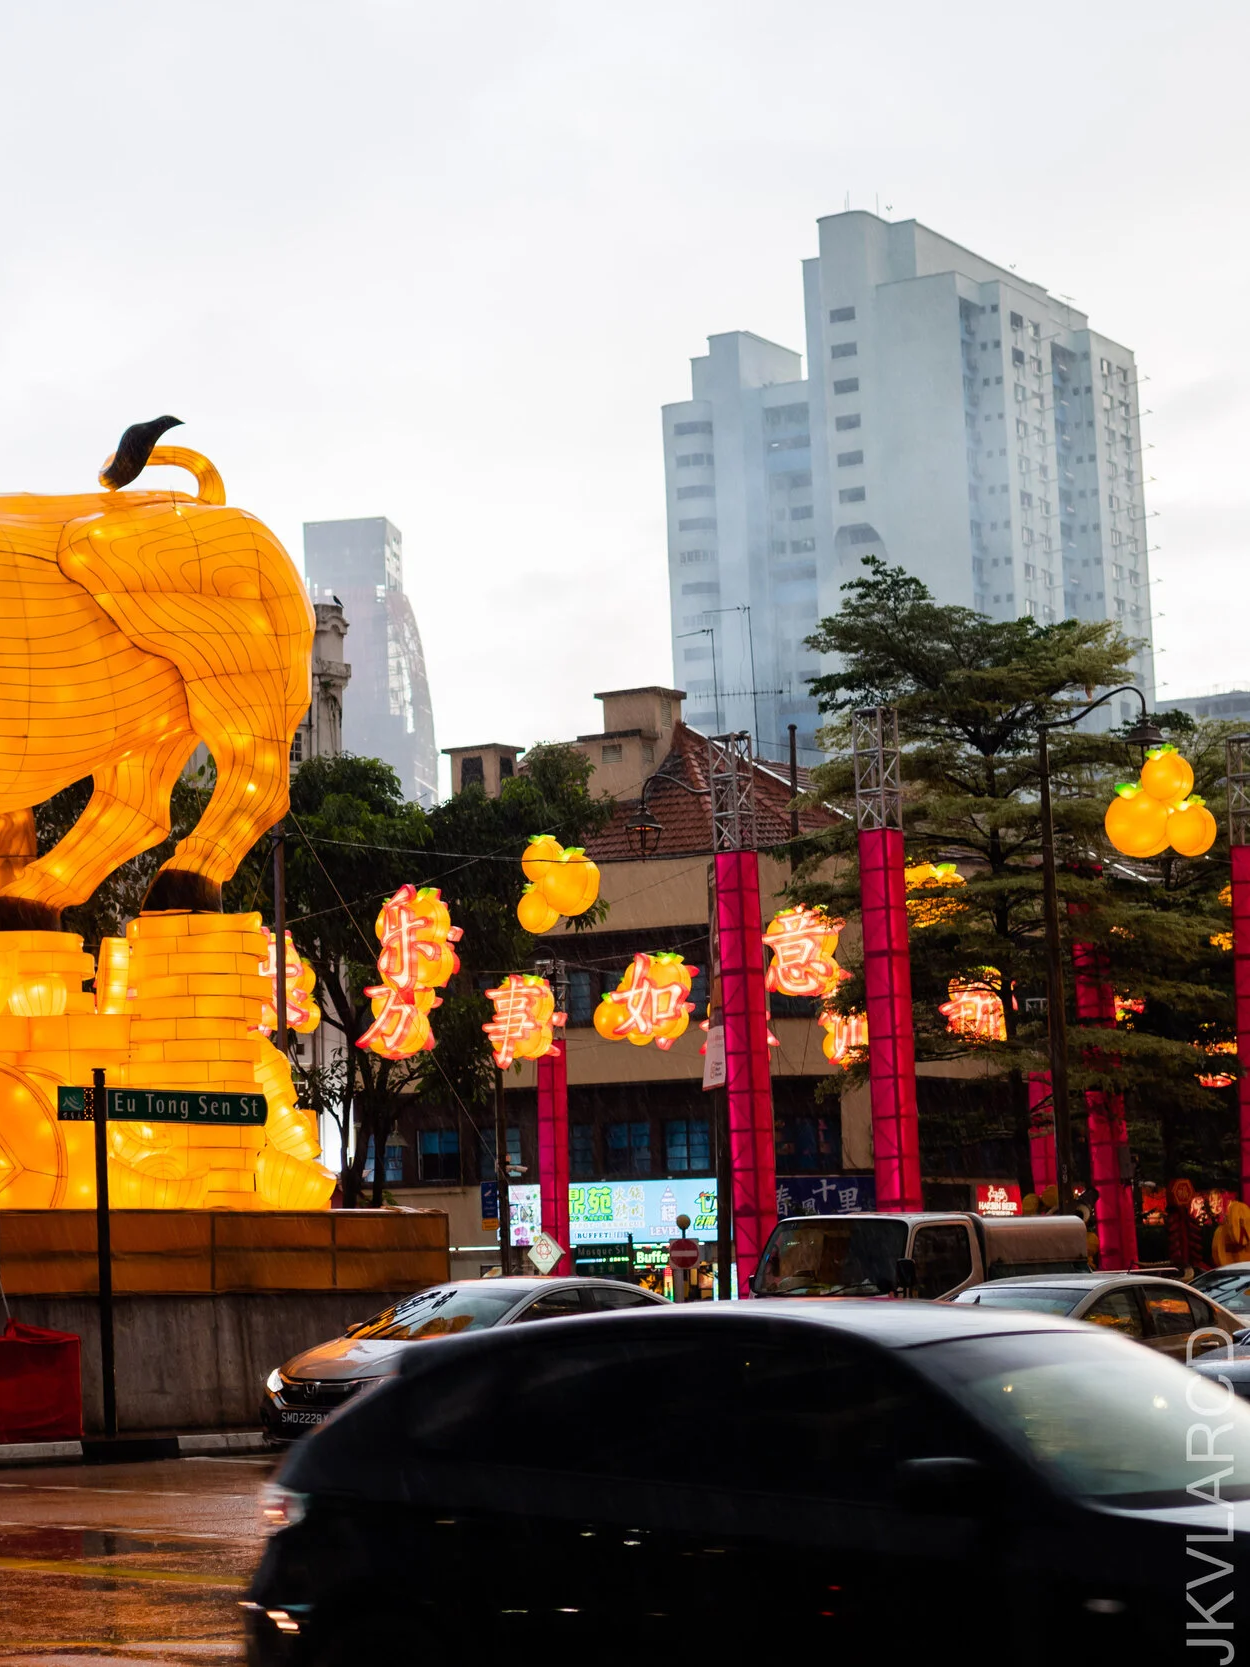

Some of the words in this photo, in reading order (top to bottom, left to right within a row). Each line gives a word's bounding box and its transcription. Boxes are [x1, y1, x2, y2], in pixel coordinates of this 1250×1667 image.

[482, 974, 547, 1070] 事
[611, 952, 690, 1037] 如
[762, 903, 847, 996] 意
[115, 1092, 136, 1113] Eu
[145, 1093, 189, 1119] Tong
[199, 1095, 231, 1116] Sen
[240, 1097, 259, 1117] St
[650, 1225, 680, 1236] LEVEL
[577, 1247, 613, 1258] Mosque
[636, 1250, 670, 1264] Buffe
